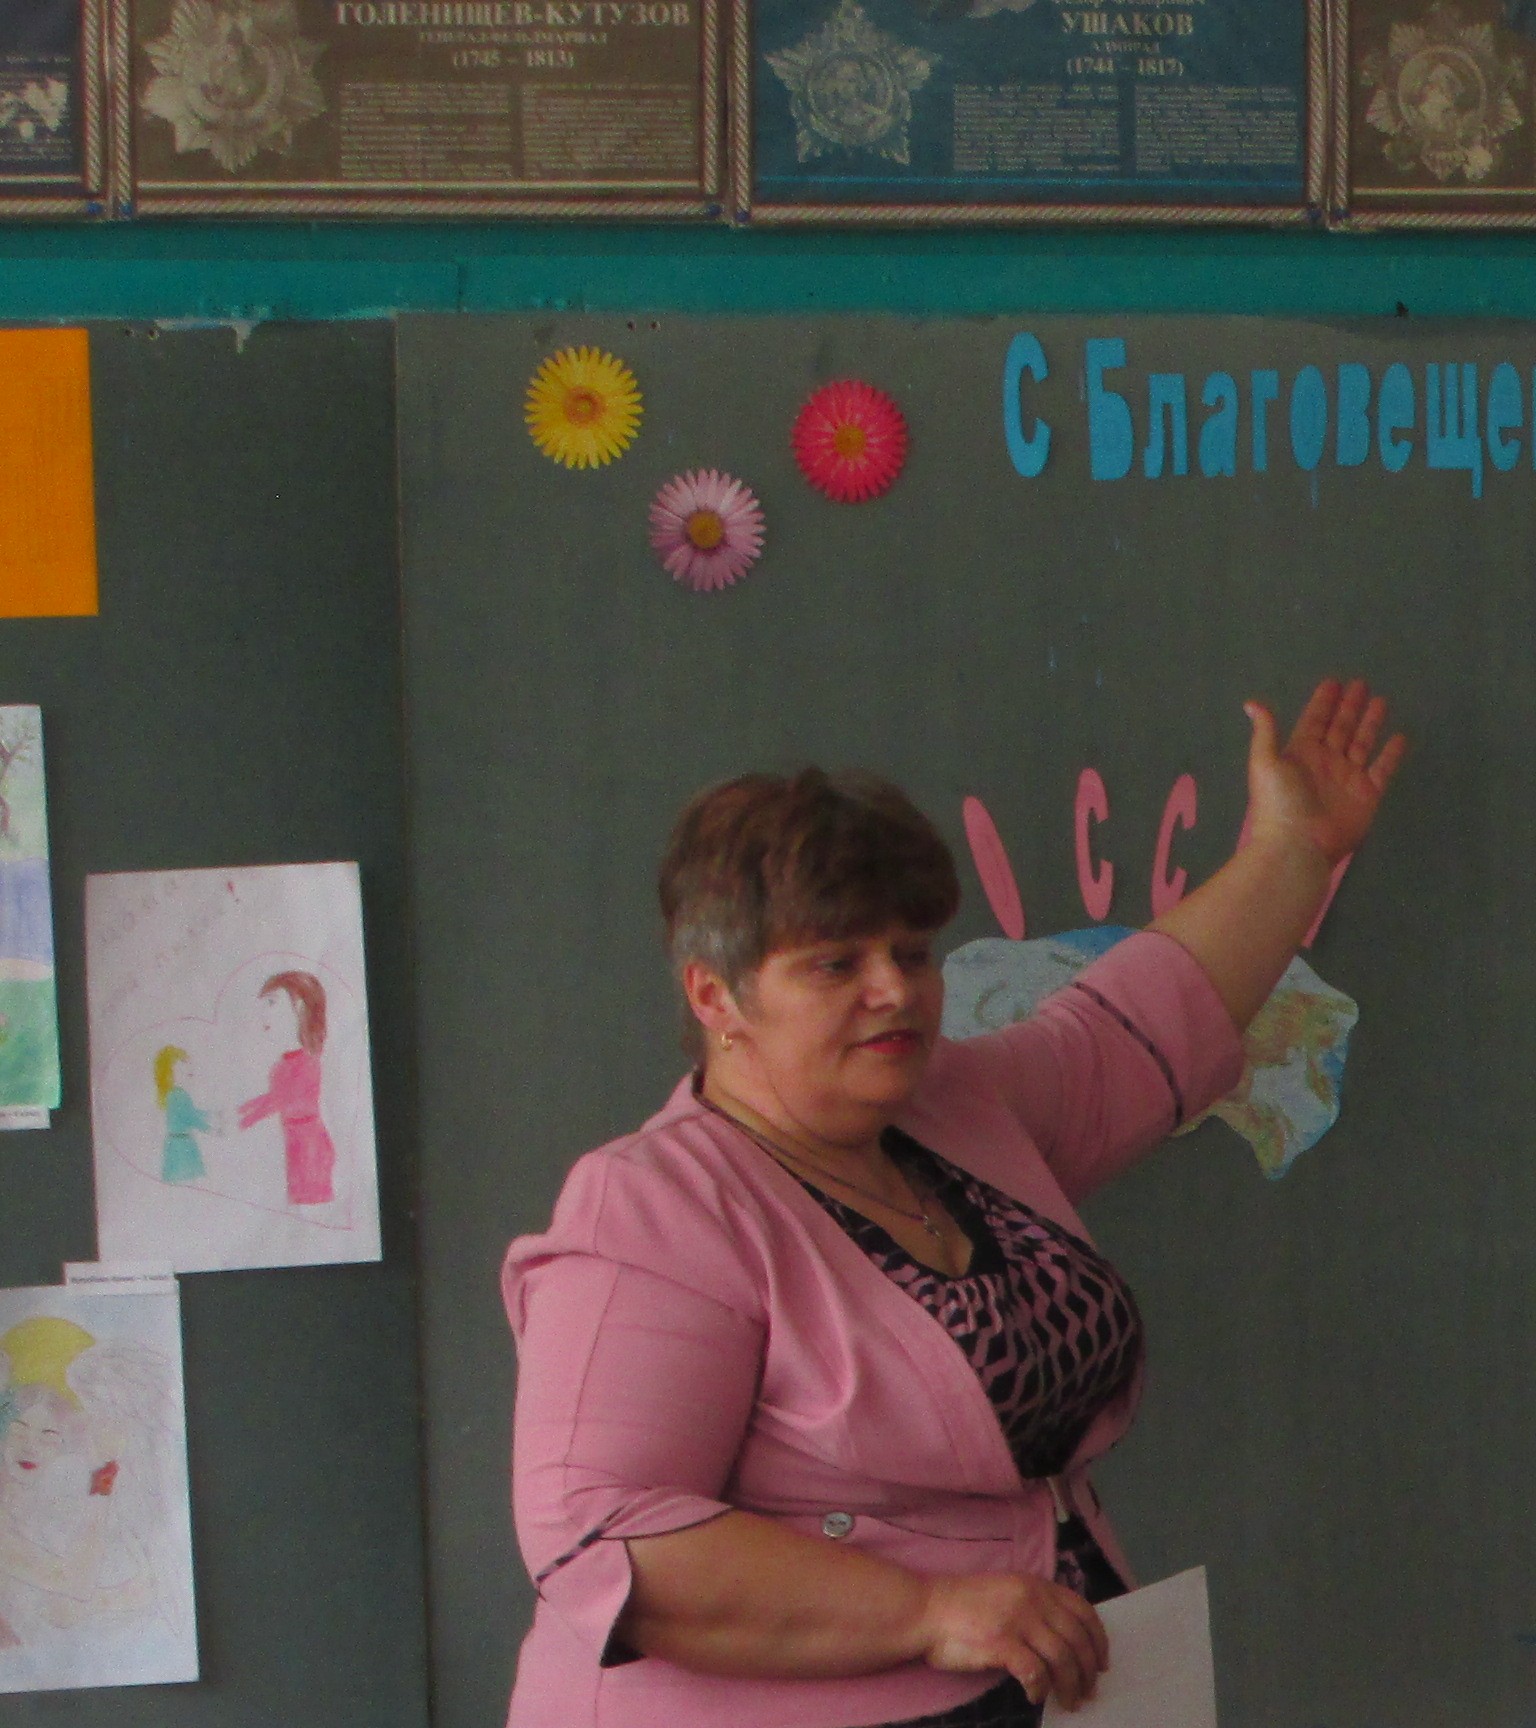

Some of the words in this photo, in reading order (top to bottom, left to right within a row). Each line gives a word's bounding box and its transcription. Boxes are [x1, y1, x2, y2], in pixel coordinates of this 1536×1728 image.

[336, 2, 690, 27] ГОЛЕНИЩЕВ-КУТУЗОВ
[1061, 11, 1193, 35] УШАКОВ
[1003, 331, 1051, 477] С
